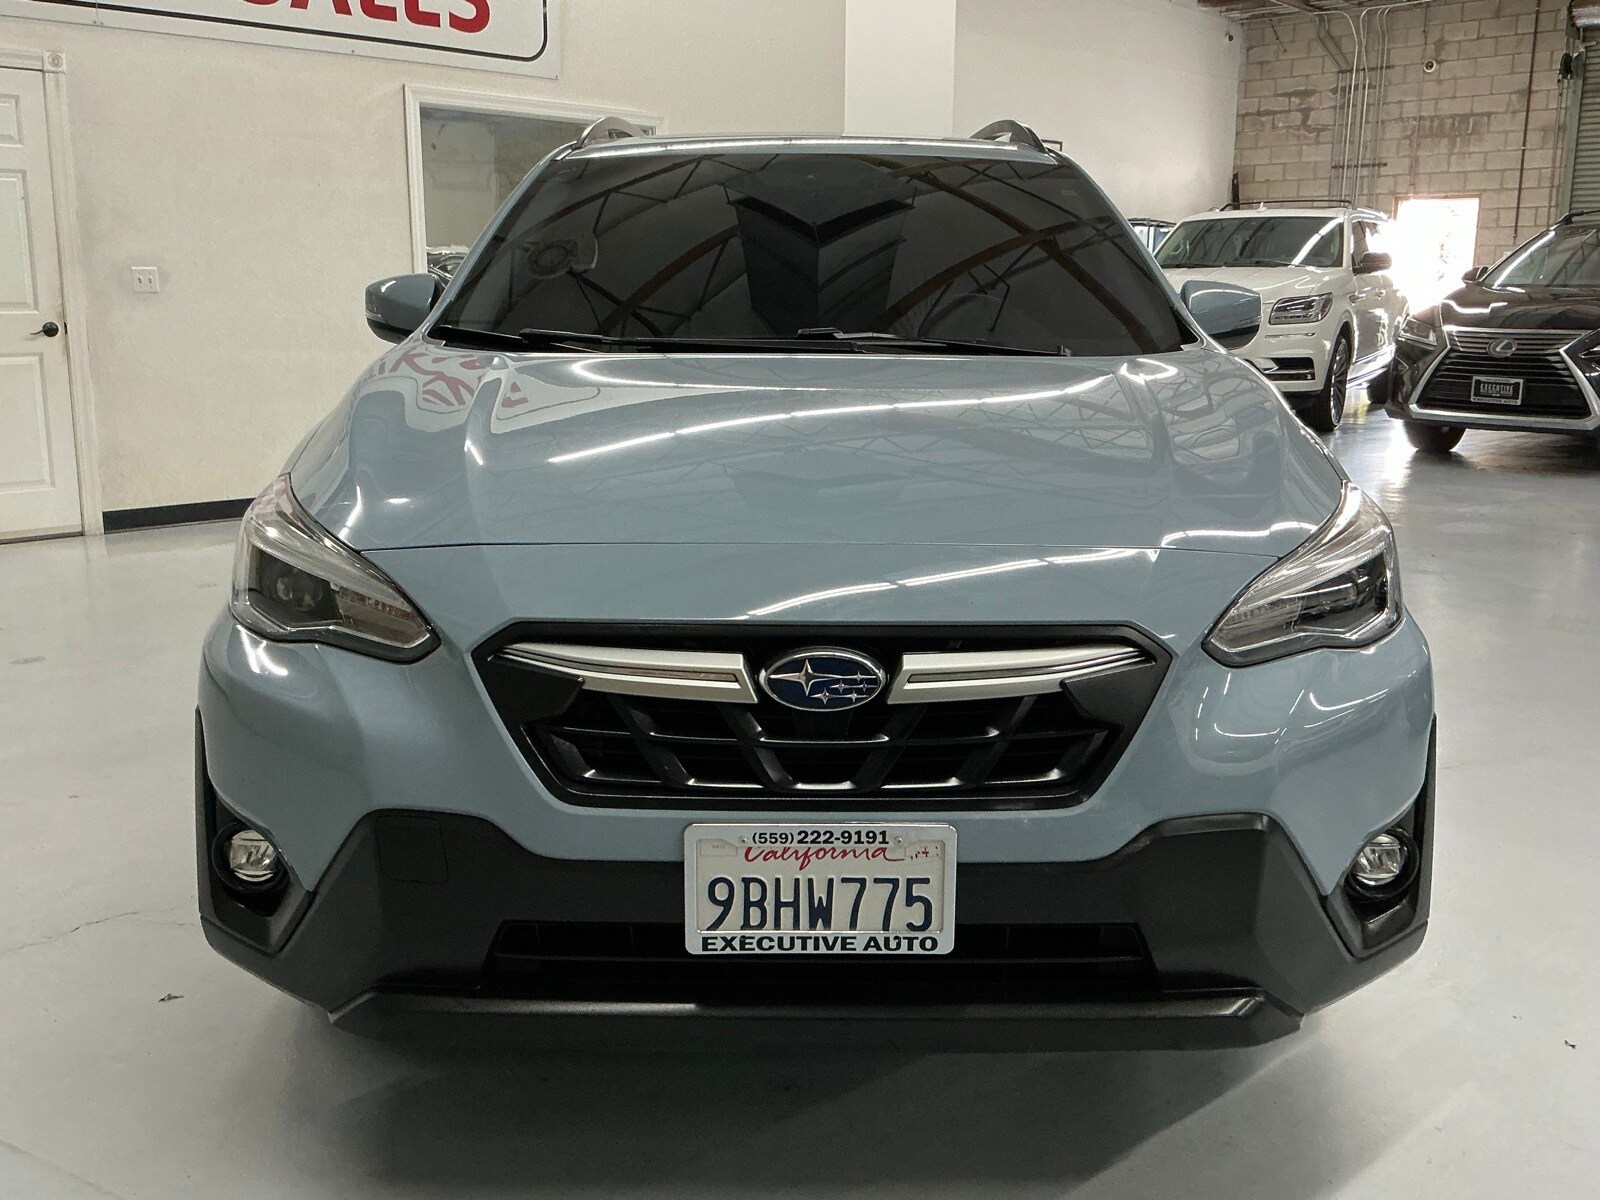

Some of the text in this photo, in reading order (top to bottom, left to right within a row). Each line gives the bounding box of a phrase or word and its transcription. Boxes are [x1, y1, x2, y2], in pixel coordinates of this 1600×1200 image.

[752, 830, 889, 845] (559) 222-9191
[744, 846, 905, 870] California
[706, 877, 932, 931] 9BHW775
[701, 936, 938, 951] EXECUTIVE AUTO
